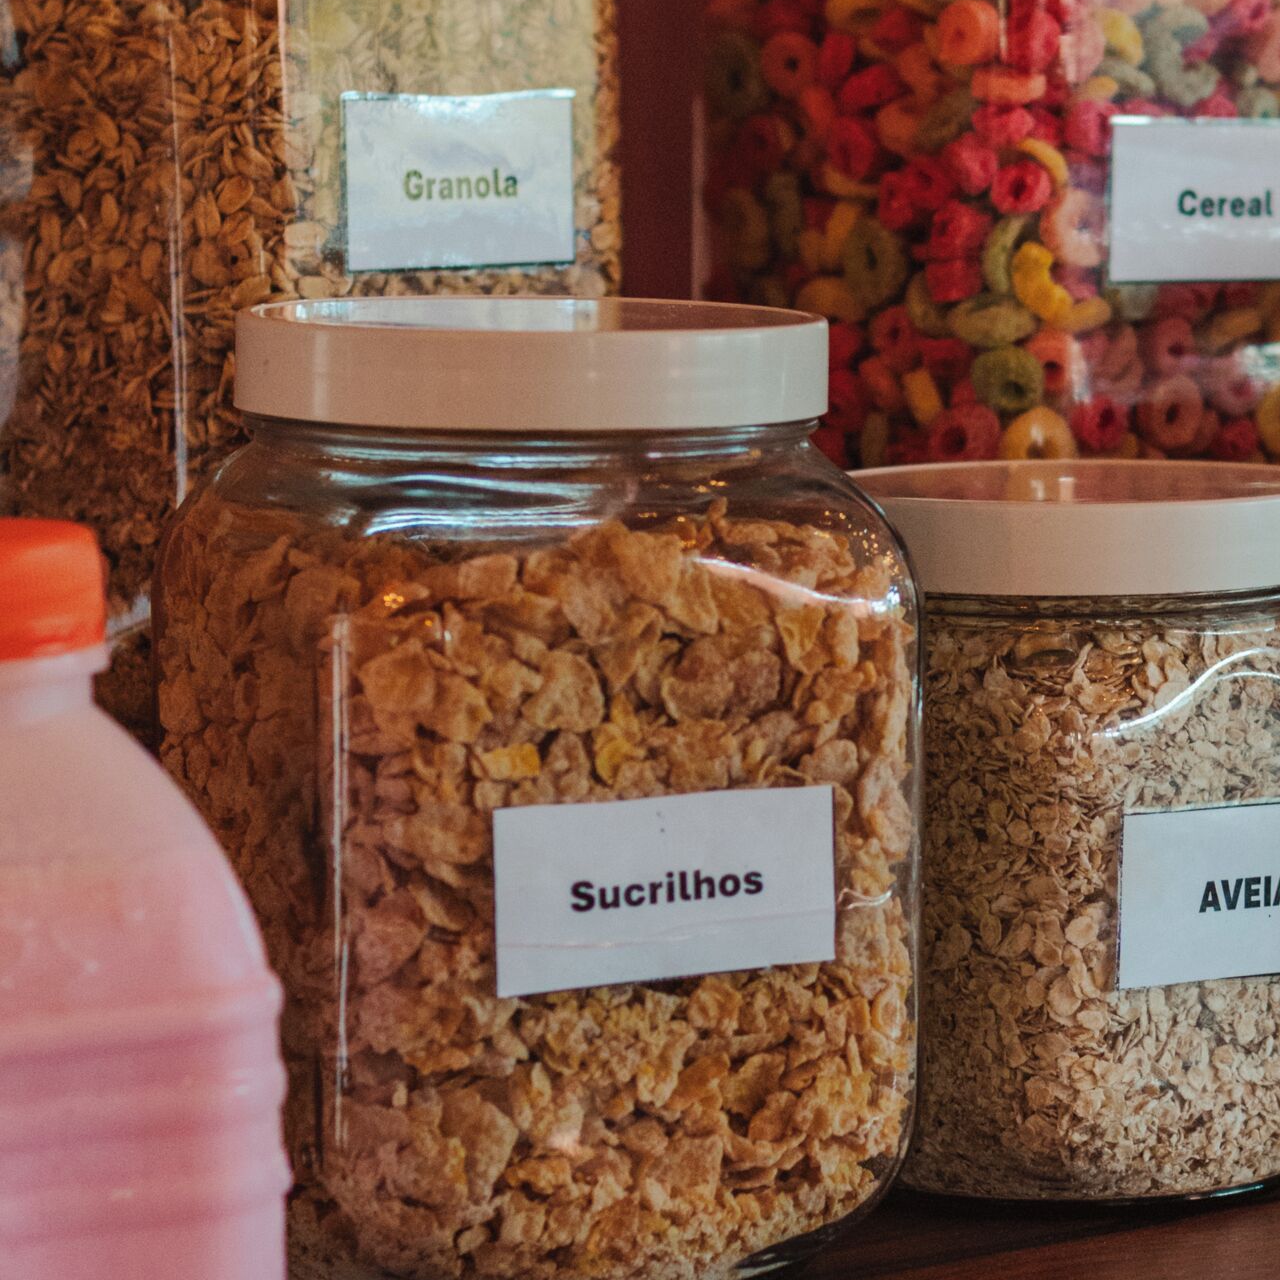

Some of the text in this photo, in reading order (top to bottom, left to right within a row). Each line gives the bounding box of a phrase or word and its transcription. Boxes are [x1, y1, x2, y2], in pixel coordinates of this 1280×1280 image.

[403, 168, 519, 201] Granola
[1177, 189, 1273, 218] Cereal
[570, 869, 764, 913] Sucrilhos
